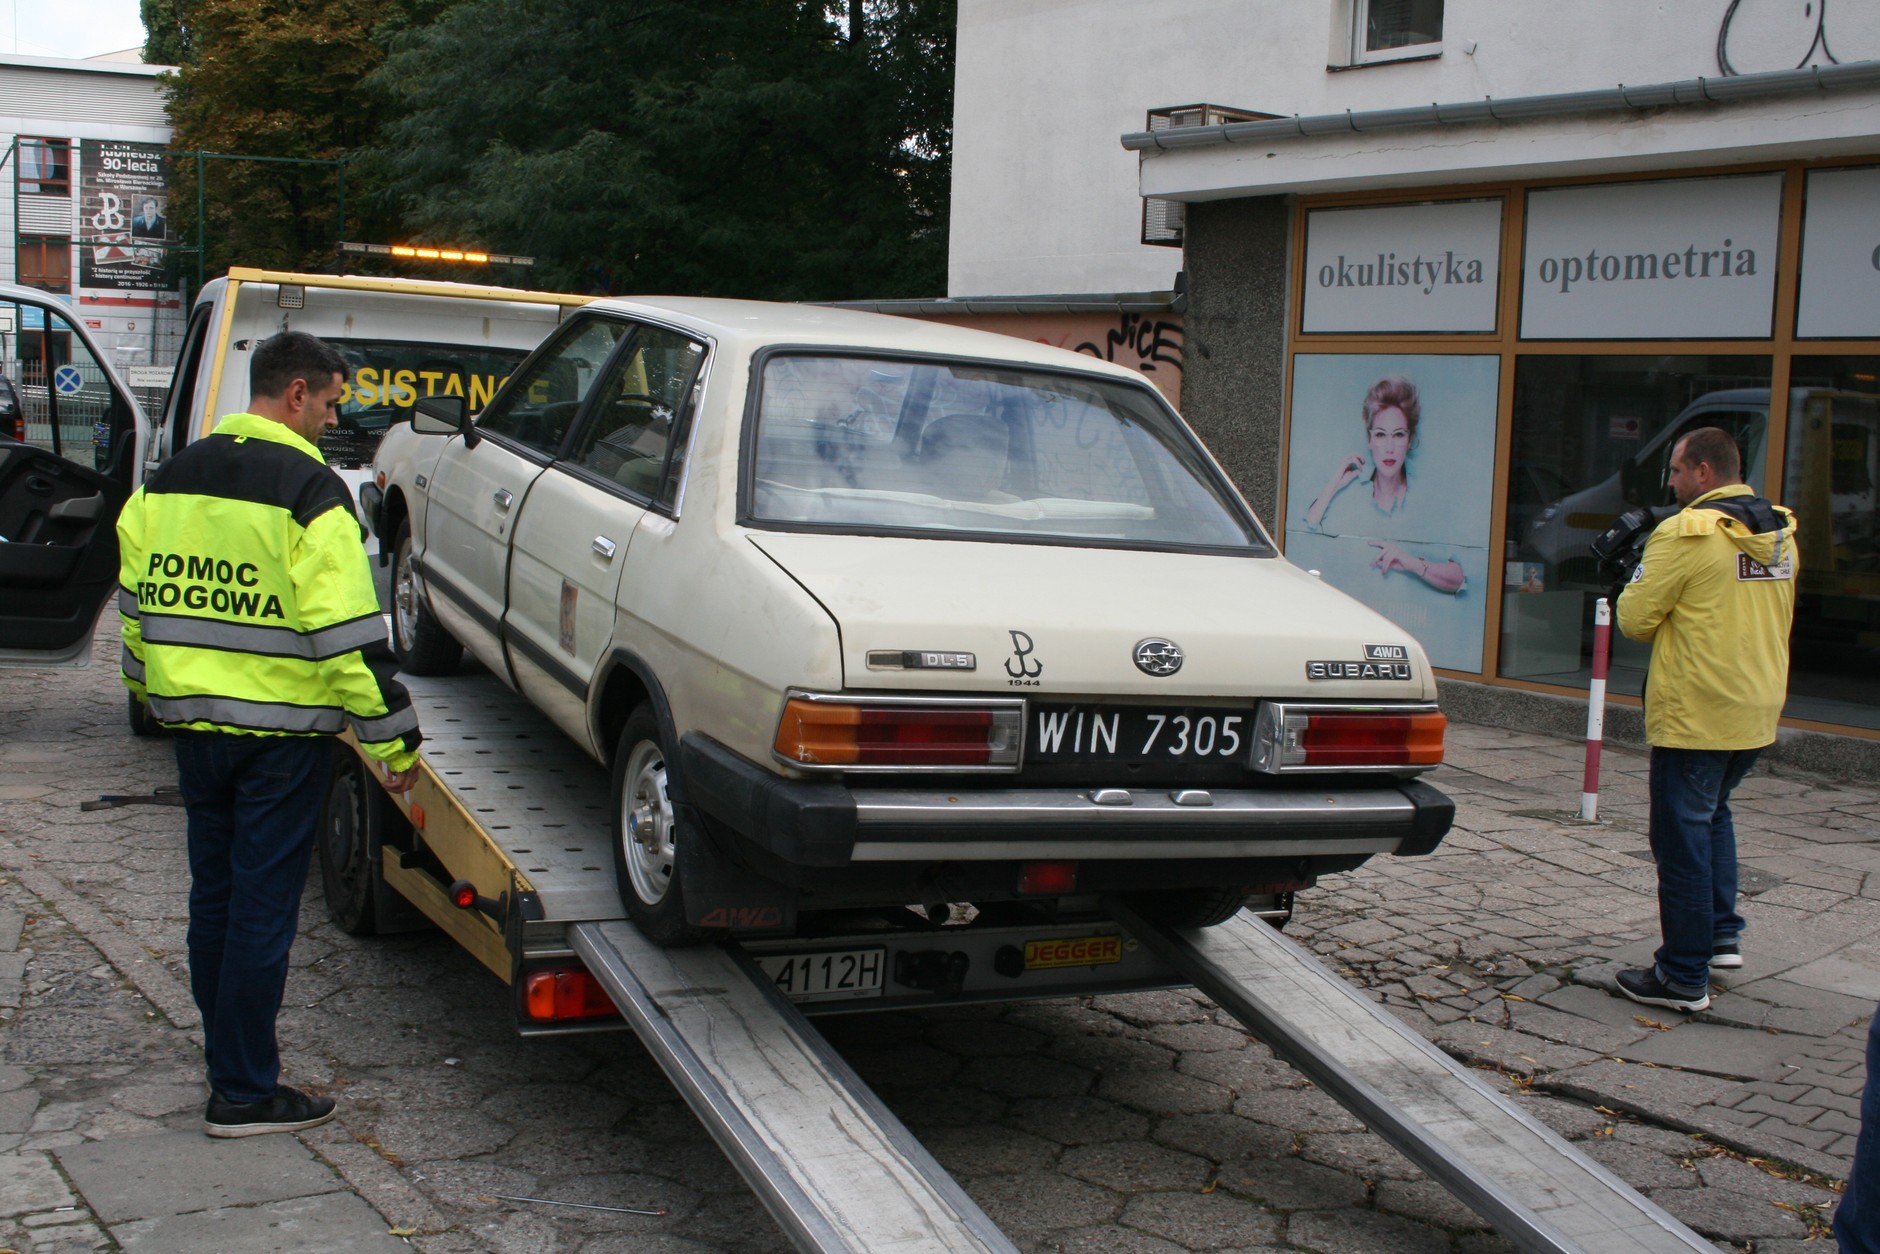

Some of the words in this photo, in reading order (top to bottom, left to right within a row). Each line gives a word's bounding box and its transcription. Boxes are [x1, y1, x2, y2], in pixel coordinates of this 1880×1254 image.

[103, 158, 159, 173] 90-lecia
[1319, 251, 1483, 295] okulistyka
[1539, 238, 1757, 293] optometria
[148, 553, 259, 588] POMOC
[927, 654, 968, 667] DL-5
[1373, 646, 1403, 658] 4WD
[1309, 662, 1410, 678] SUBARU
[1008, 679, 1041, 687] 1944
[1039, 712, 1120, 754] WIN
[1141, 714, 1242, 756] 7305
[1026, 940, 1119, 962] JEGGER
[775, 952, 879, 992] 4112H
